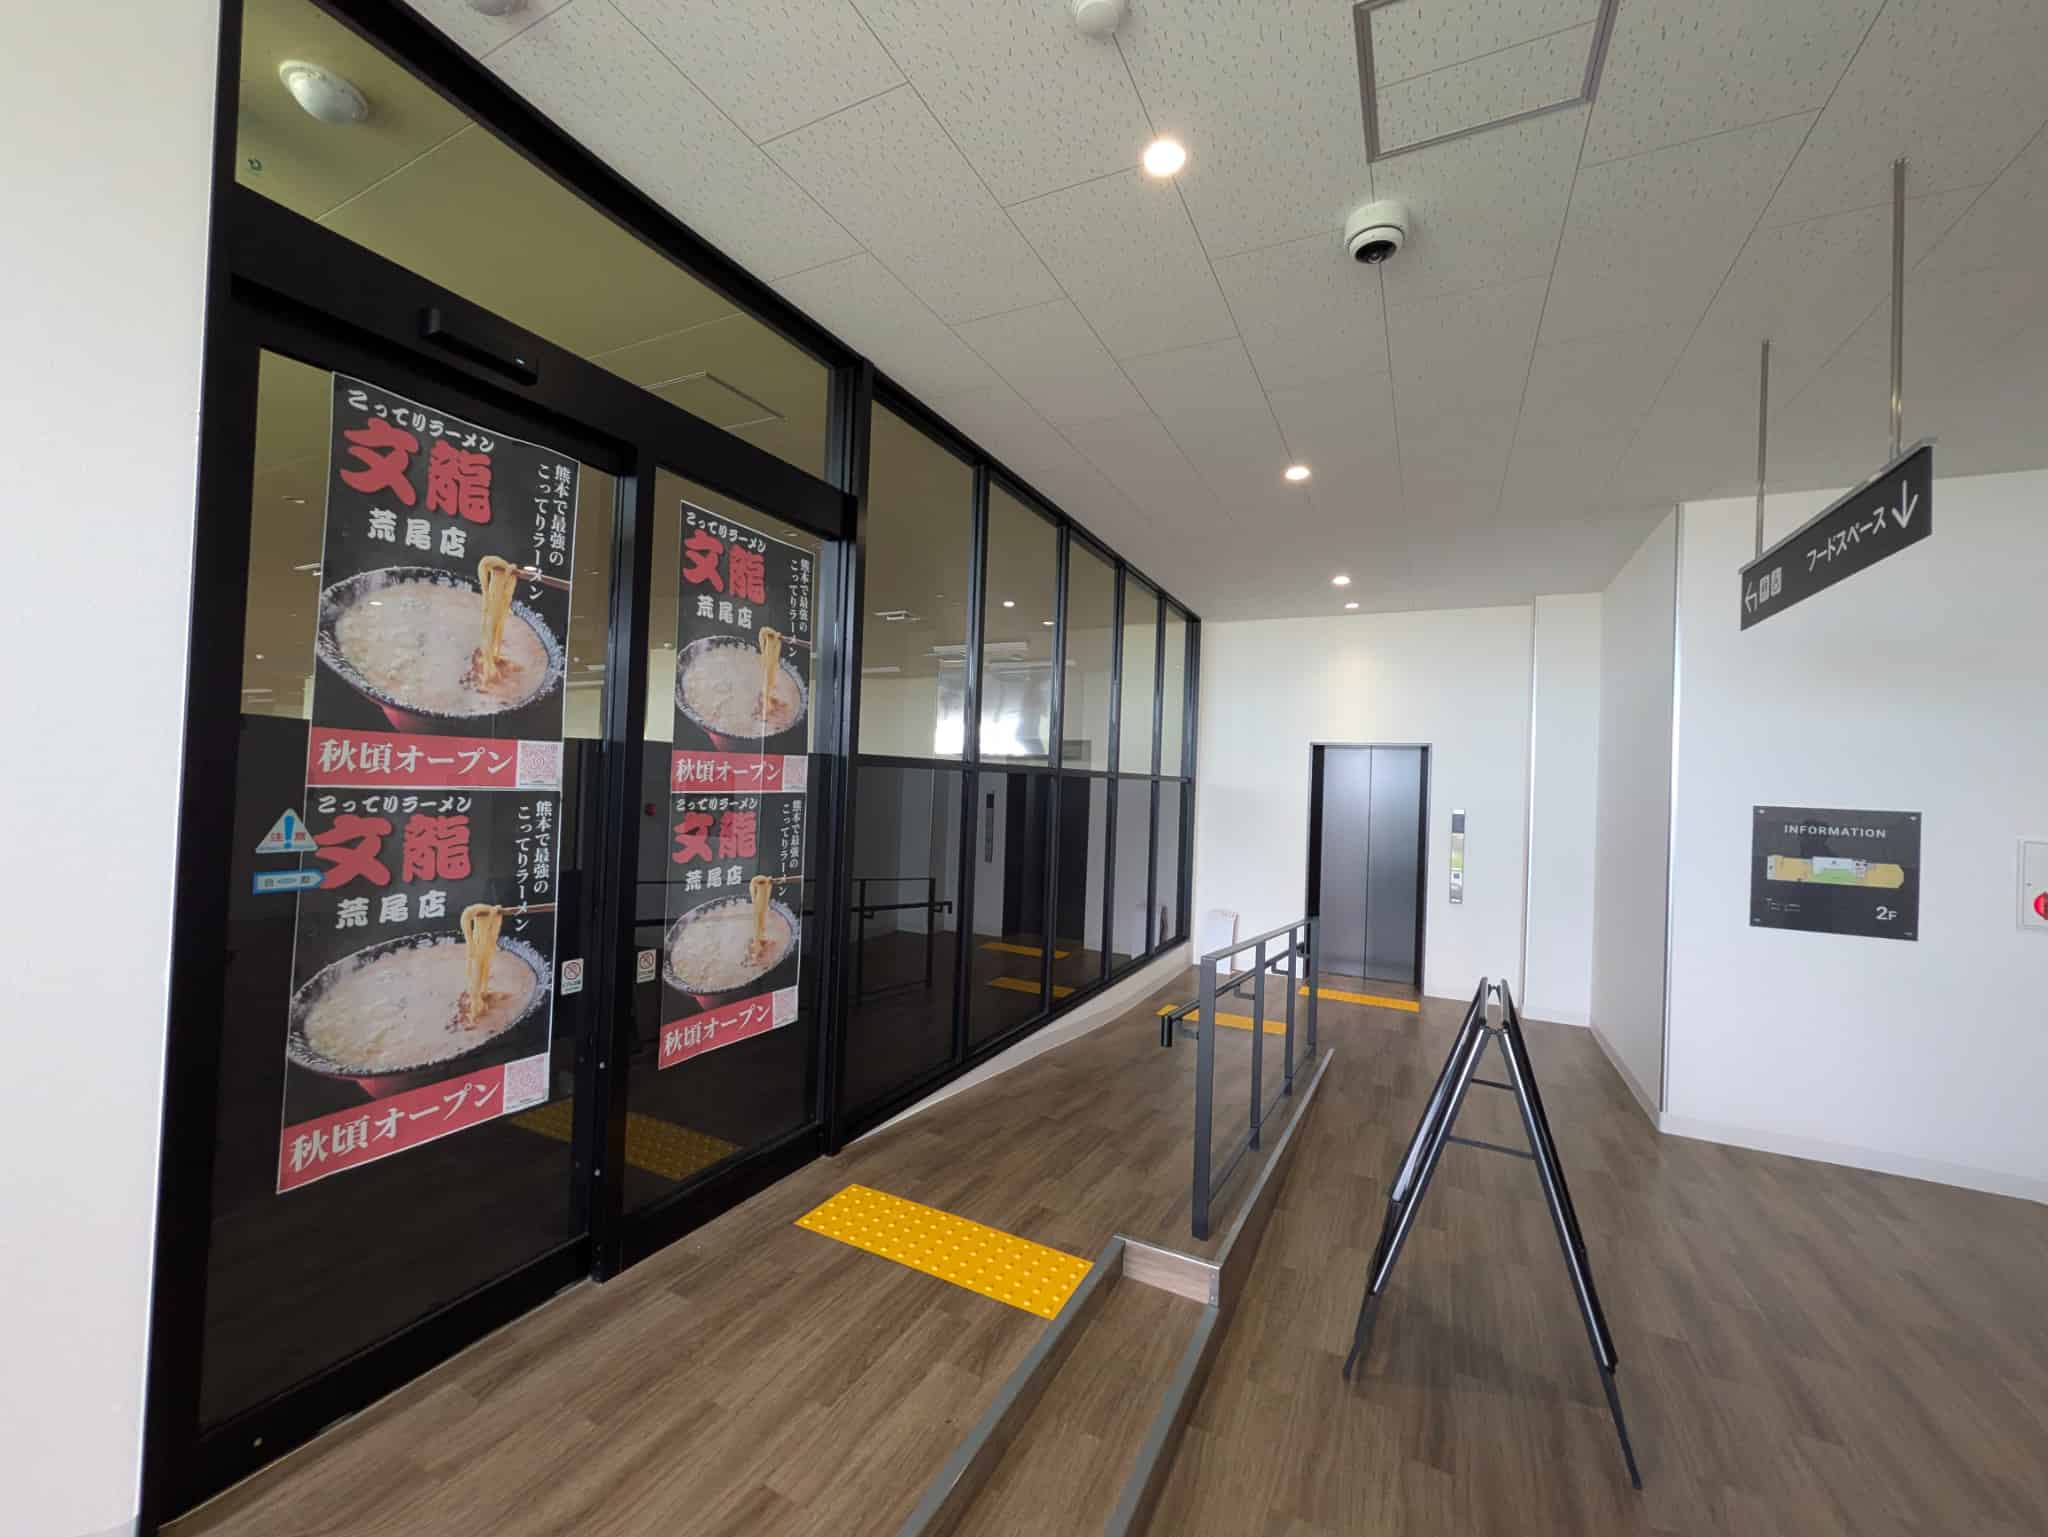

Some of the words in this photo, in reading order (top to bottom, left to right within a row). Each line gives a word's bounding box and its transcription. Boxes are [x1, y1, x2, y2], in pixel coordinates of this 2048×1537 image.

[347, 389, 495, 453] こってりラーメン
[367, 508, 468, 560] 荒尾店
[530, 463, 551, 601] こってりラーメン
[549, 463, 571, 568] 熊本で最強の
[685, 511, 767, 553] こってりラーメン
[696, 595, 752, 630] 荒尾店
[318, 740, 514, 774] 秋頃オープン
[675, 757, 781, 784] 秋頃オープン
[318, 794, 473, 815] こってりラーメン
[533, 799, 553, 894] 熊本で最強の
[1783, 824, 1887, 839] INFORMATION
[515, 804, 533, 932] こってりラーメン
[684, 864, 743, 892] 荒尾店
[335, 889, 447, 930] 荒尾店
[1875, 905, 1897, 921] 2F
[663, 1003, 771, 1058] 秋頃オープン
[288, 1081, 499, 1173] 秋頃オープン
